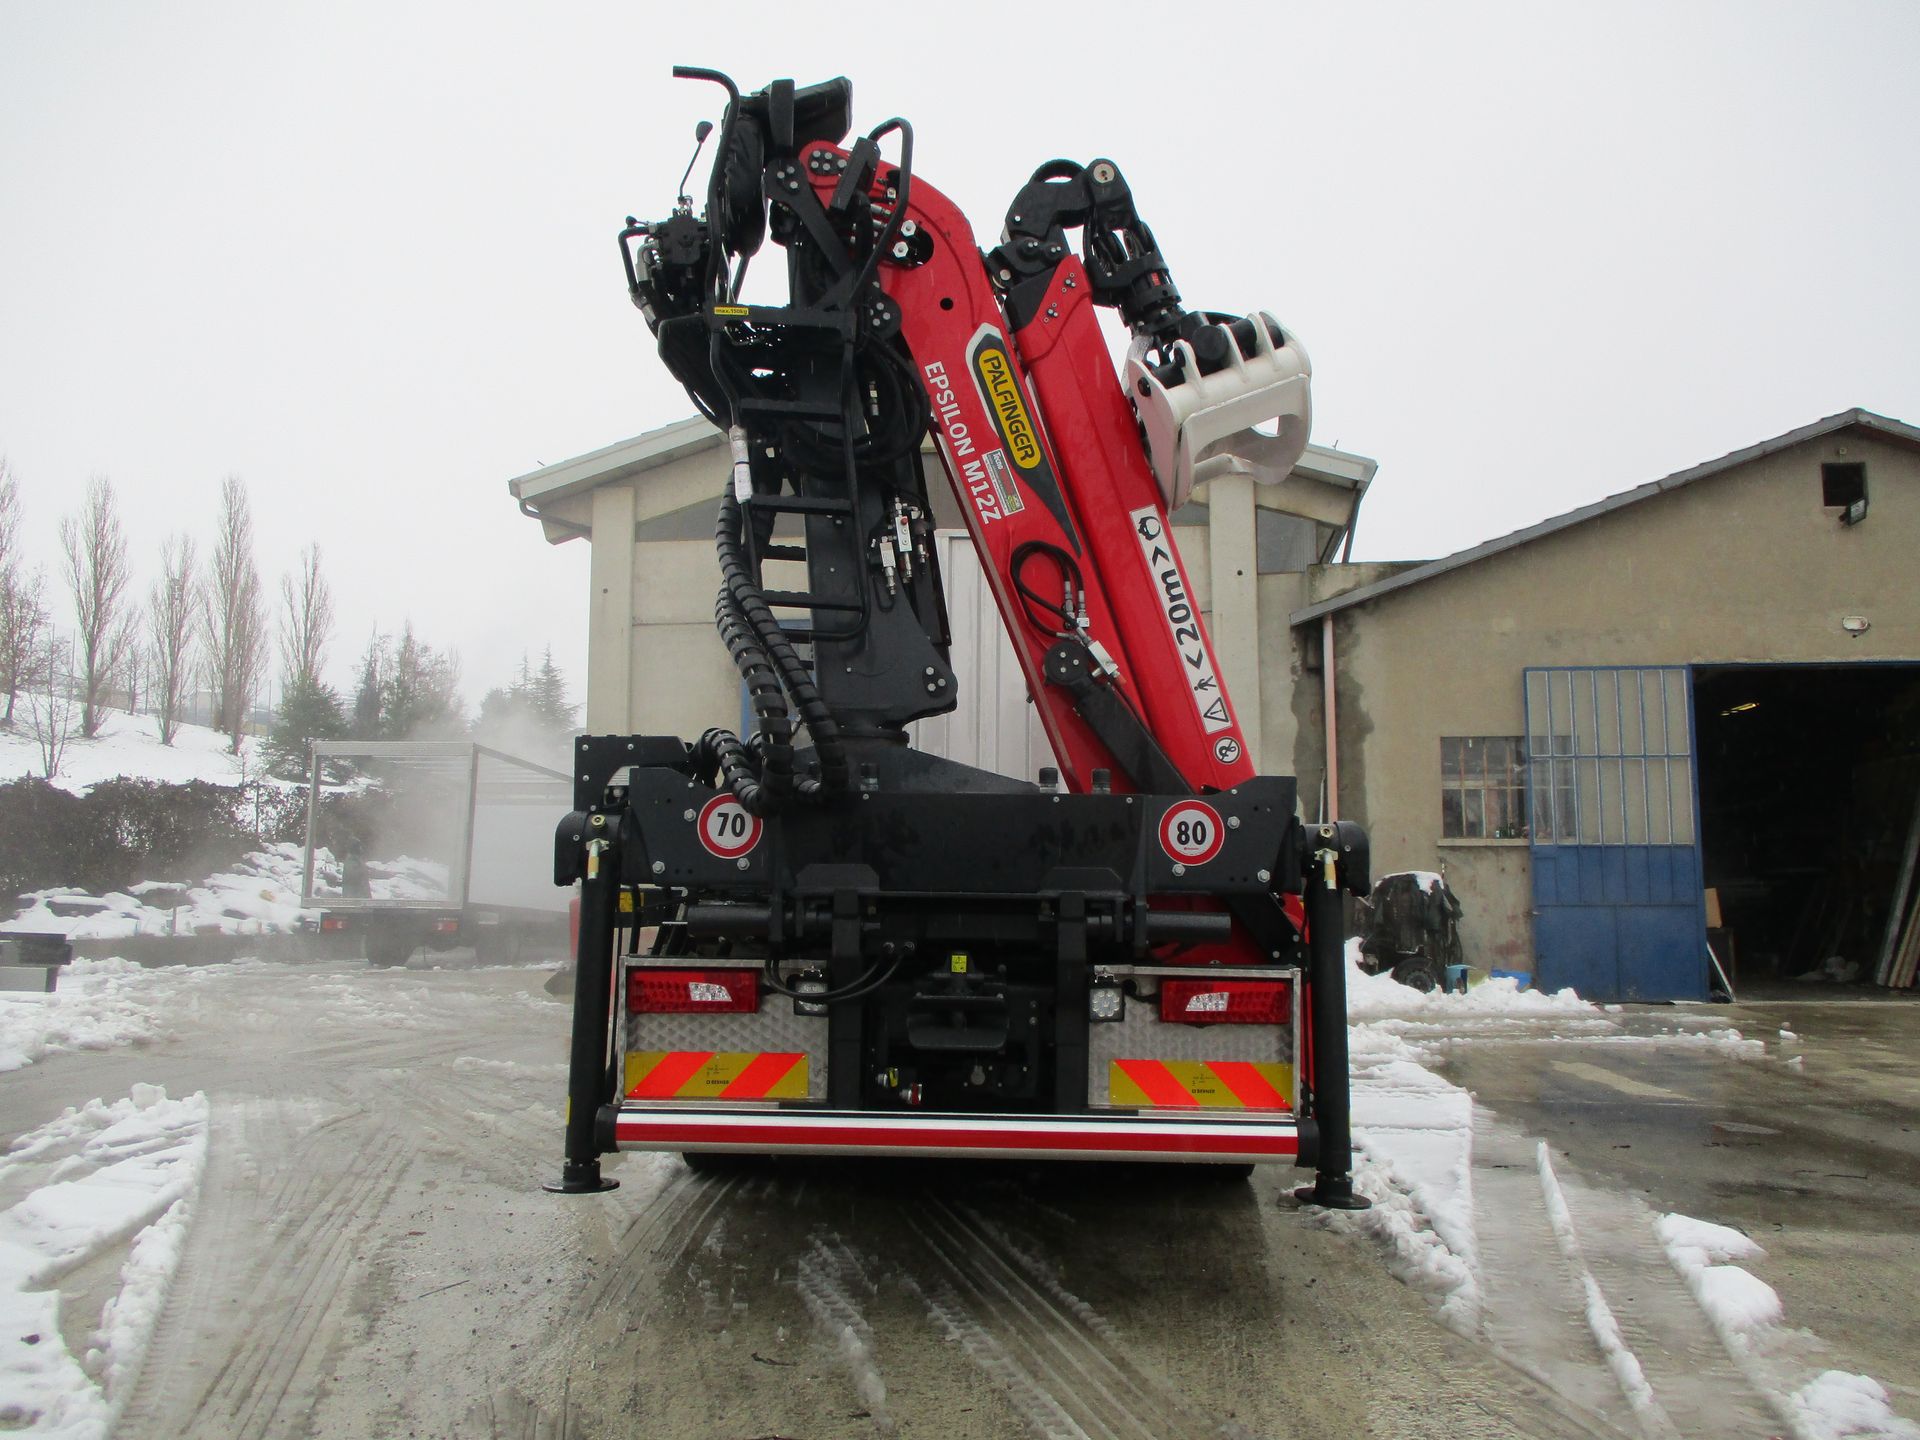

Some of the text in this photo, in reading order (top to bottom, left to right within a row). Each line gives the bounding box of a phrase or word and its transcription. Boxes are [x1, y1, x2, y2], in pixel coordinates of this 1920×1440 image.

[925, 361, 976, 457] EPSILON
[963, 459, 1002, 525] M12Z
[983, 355, 1036, 462] PALFINGER
[1161, 568, 1200, 646] 20m
[717, 812, 746, 838] 70
[1177, 820, 1207, 846] 80
